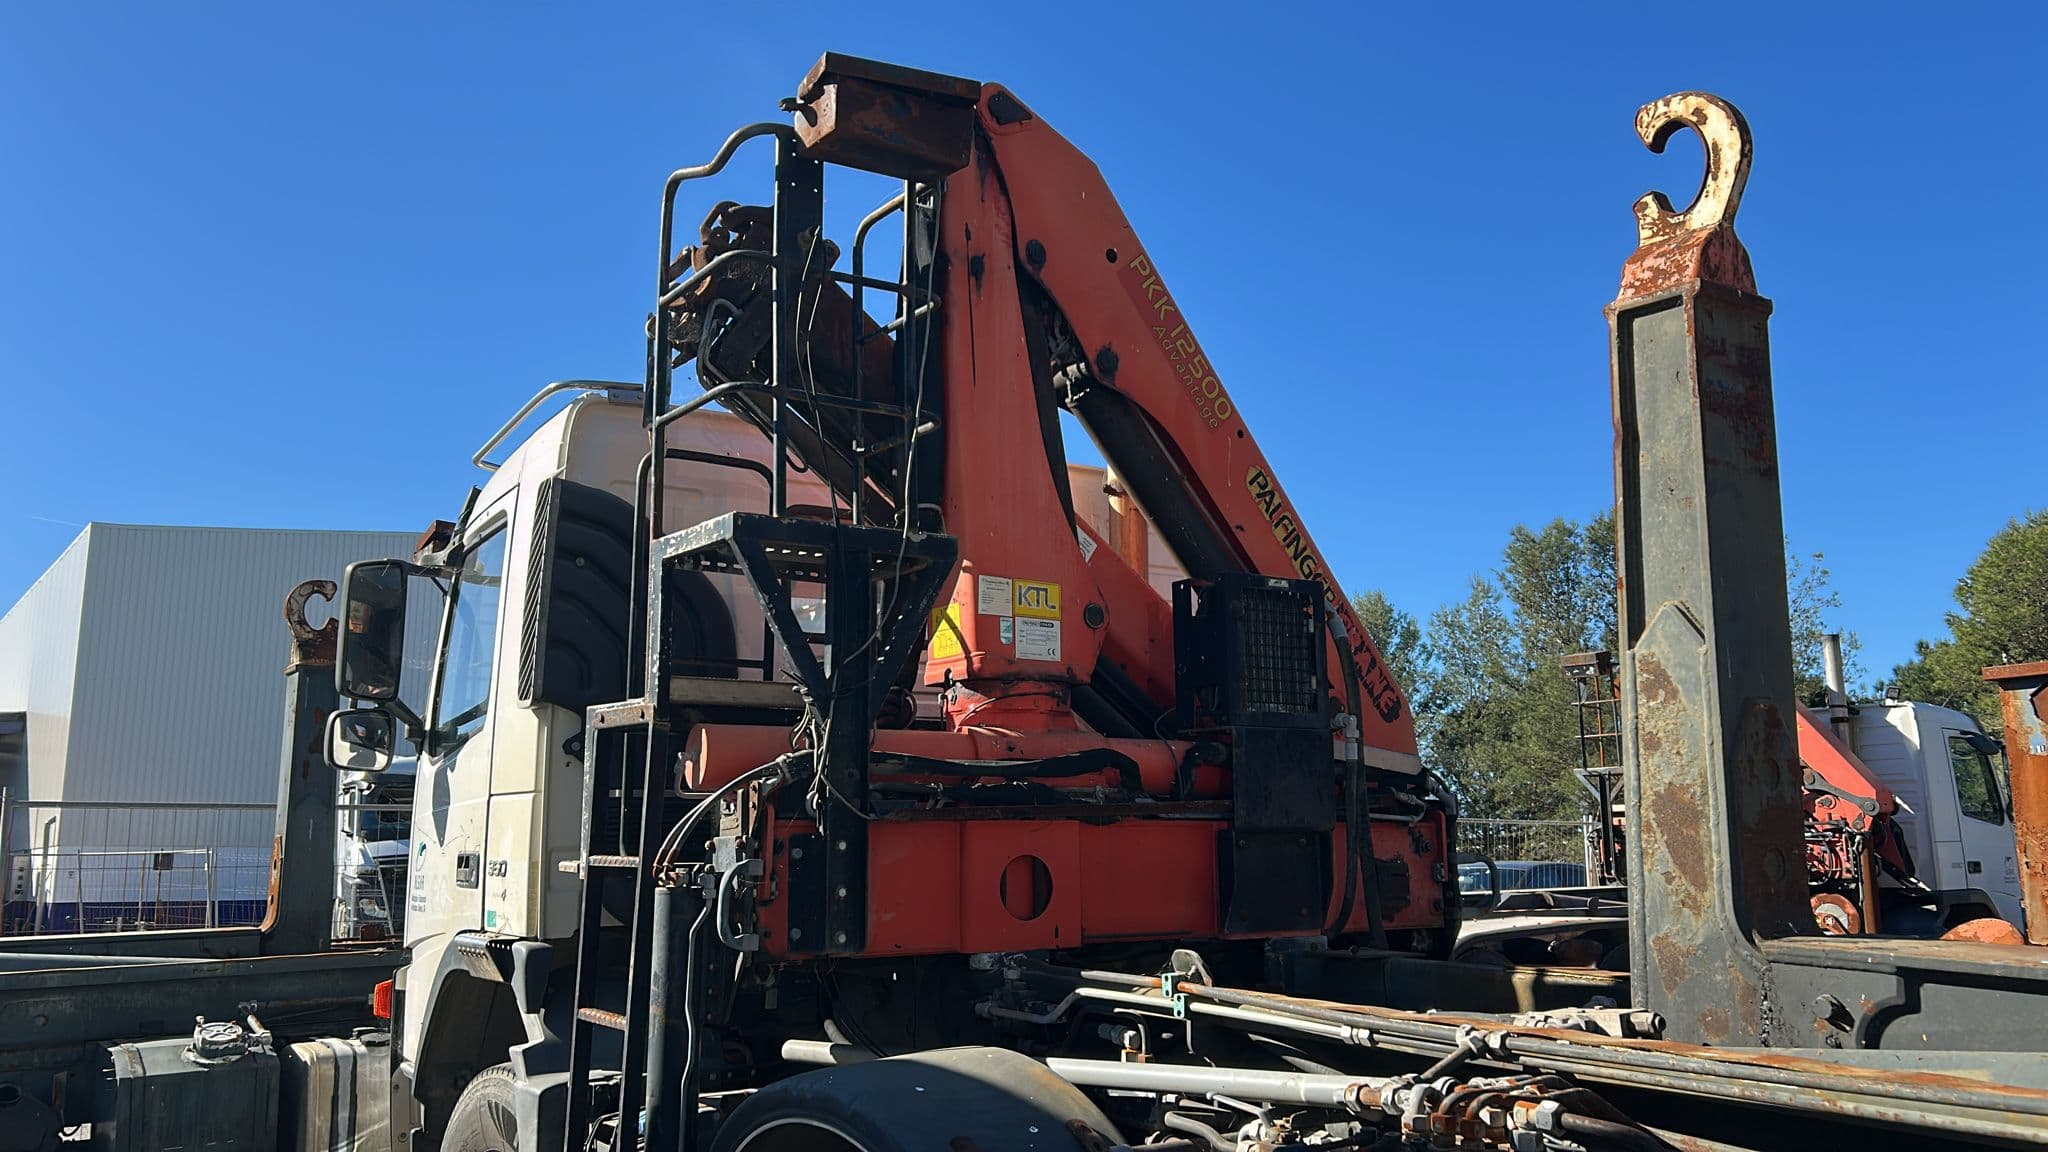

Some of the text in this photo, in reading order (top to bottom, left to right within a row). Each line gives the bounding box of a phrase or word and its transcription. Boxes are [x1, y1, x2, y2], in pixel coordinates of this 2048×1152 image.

[1129, 254, 1232, 421] PKK 12500
[1152, 325, 1219, 429] Advantage
[1018, 584, 1057, 610] KTL
